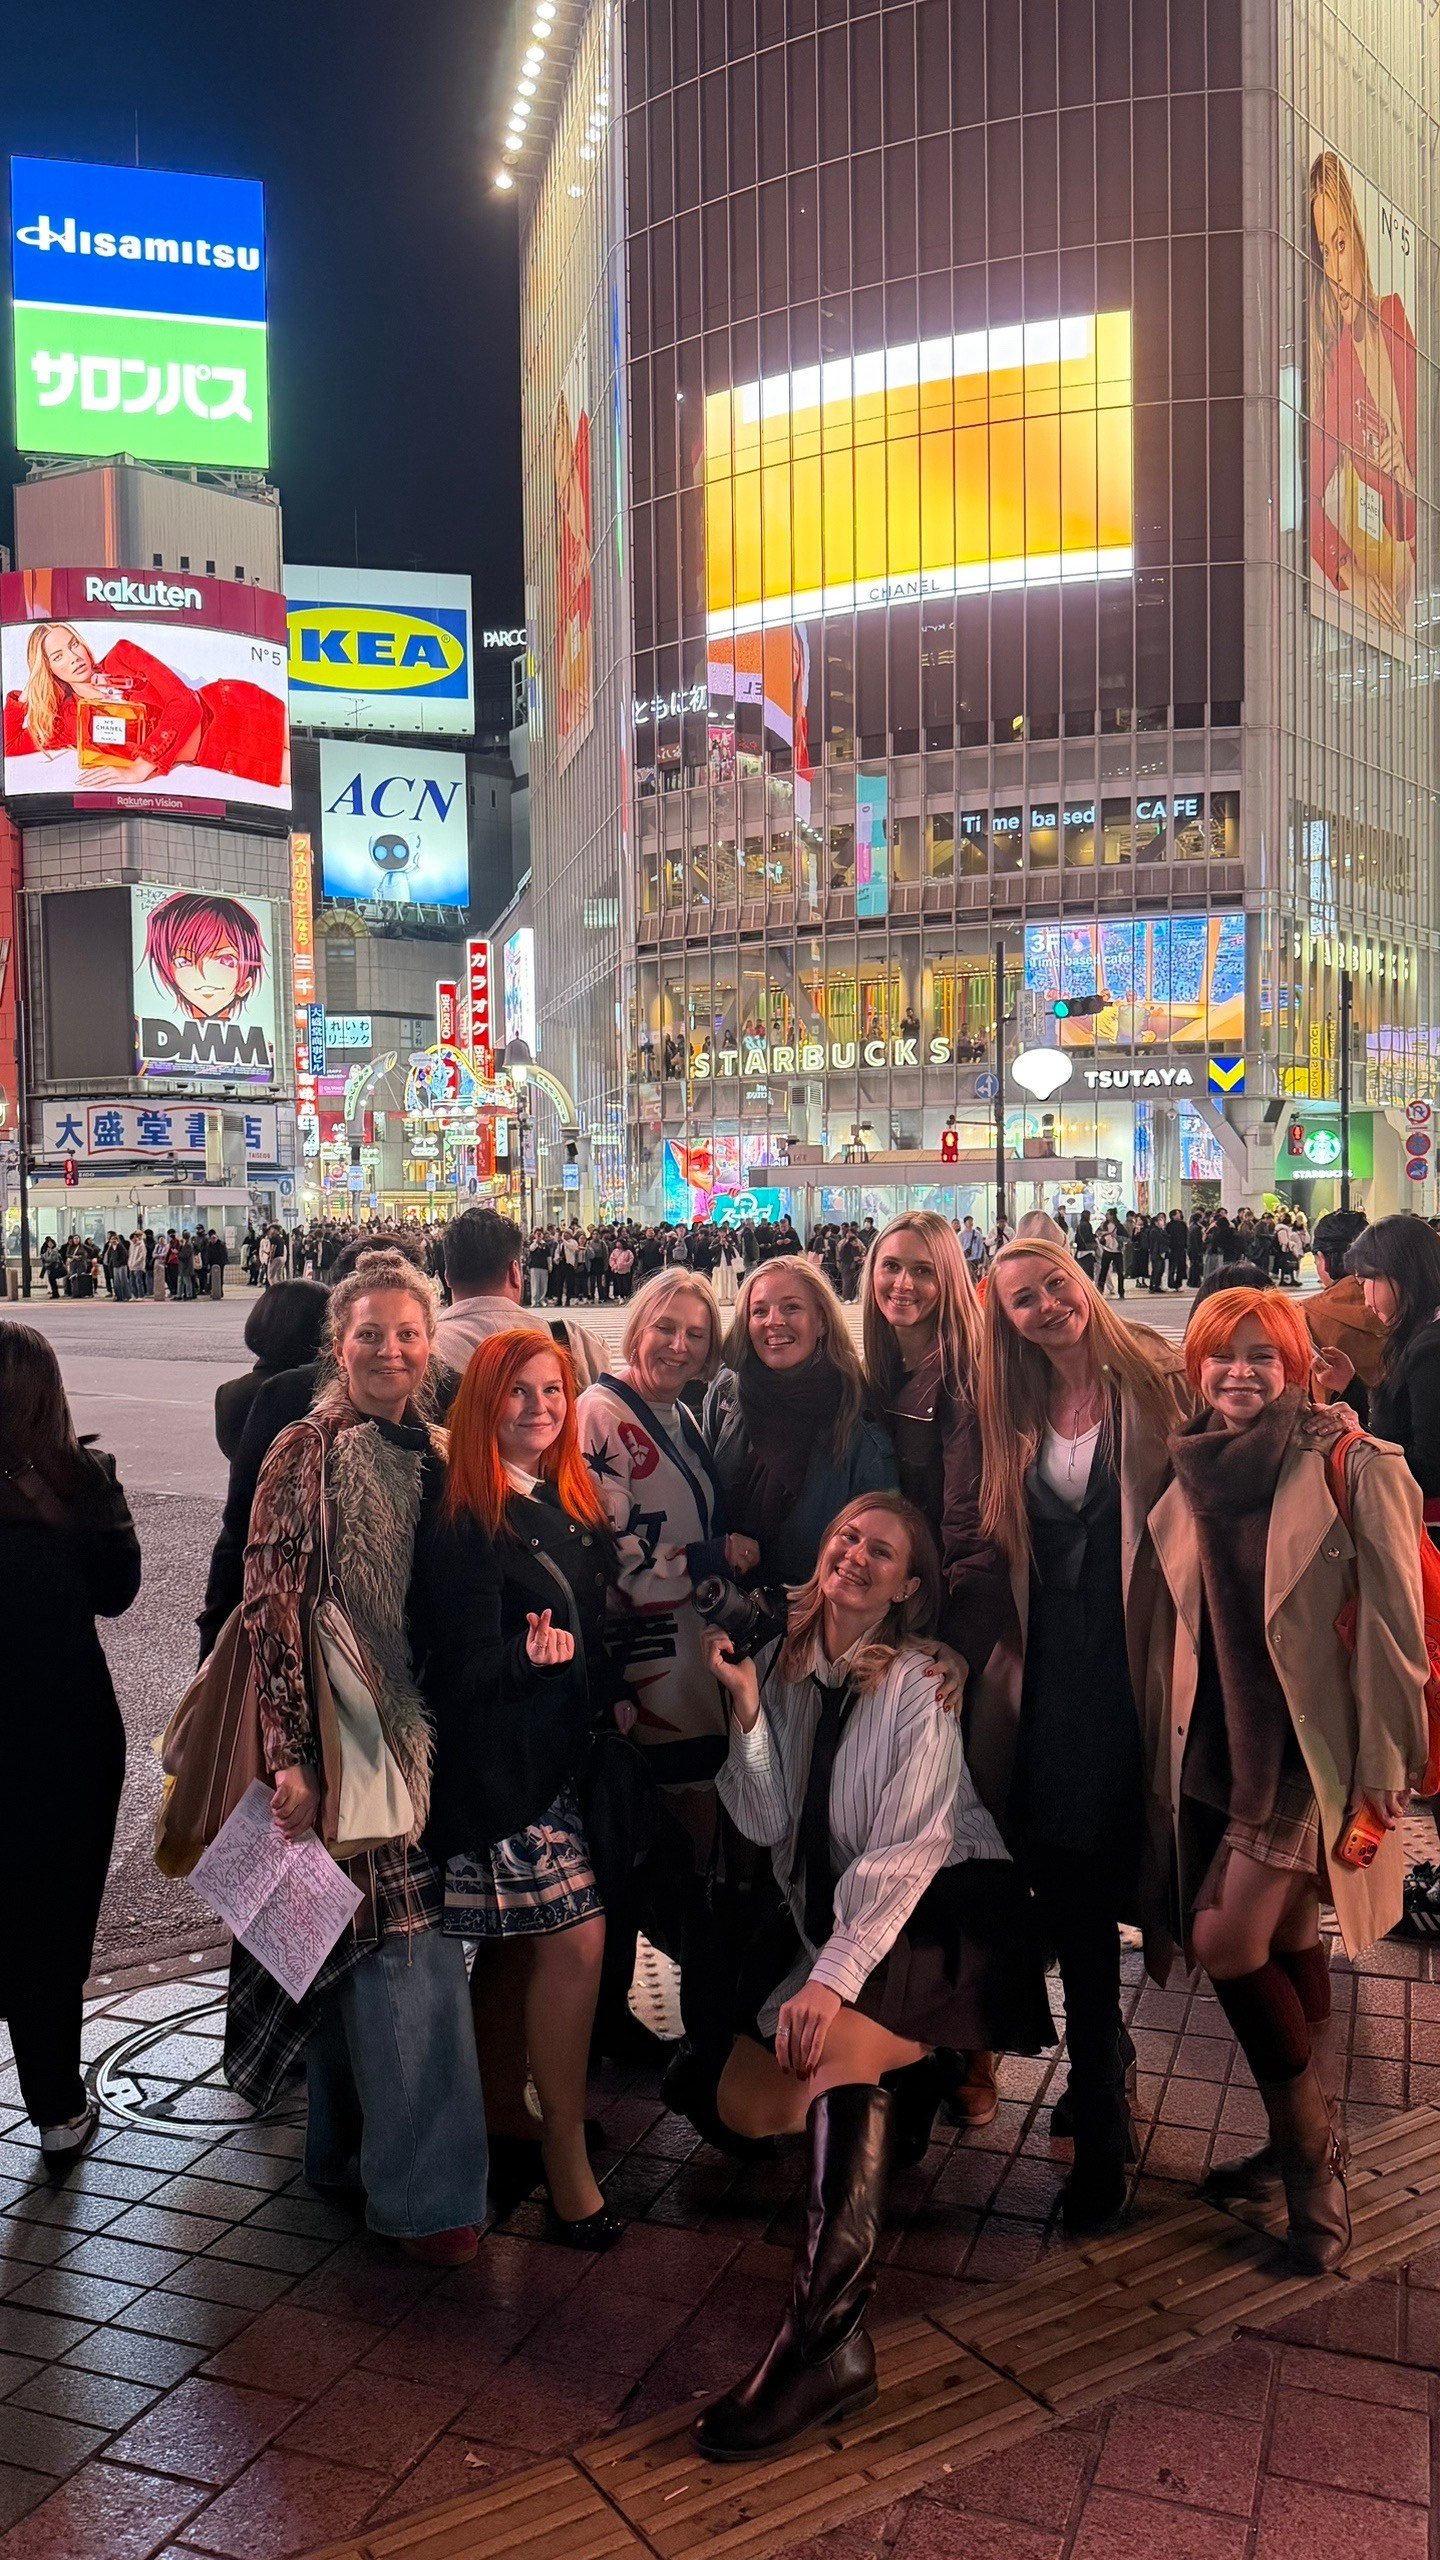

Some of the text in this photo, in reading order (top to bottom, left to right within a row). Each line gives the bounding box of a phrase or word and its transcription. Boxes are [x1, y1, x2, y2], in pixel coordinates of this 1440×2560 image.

[16, 215, 260, 271] Hisamitsu
[31, 350, 252, 424] サロンパス
[85, 576, 203, 611] Rakuten
[869, 579, 940, 600] CHANEL
[288, 626, 450, 670] KEA
[96, 724, 123, 733] CHANEL
[117, 796, 183, 808] Rakuten Vision
[325, 773, 463, 823] ACN
[1136, 799, 1198, 820] CAFE
[1104, 953, 1130, 965] cafe
[470, 952, 489, 1036] カラオケ
[142, 1018, 270, 1065] DMM
[311, 1007, 323, 1072] 大盛堂商事ビル
[325, 1034, 370, 1045] リニック
[694, 1037, 951, 1078] STARBUCKS
[1084, 1068, 1194, 1088] TSUTAYA
[1292, 1169, 1353, 1179] STARBUCS
